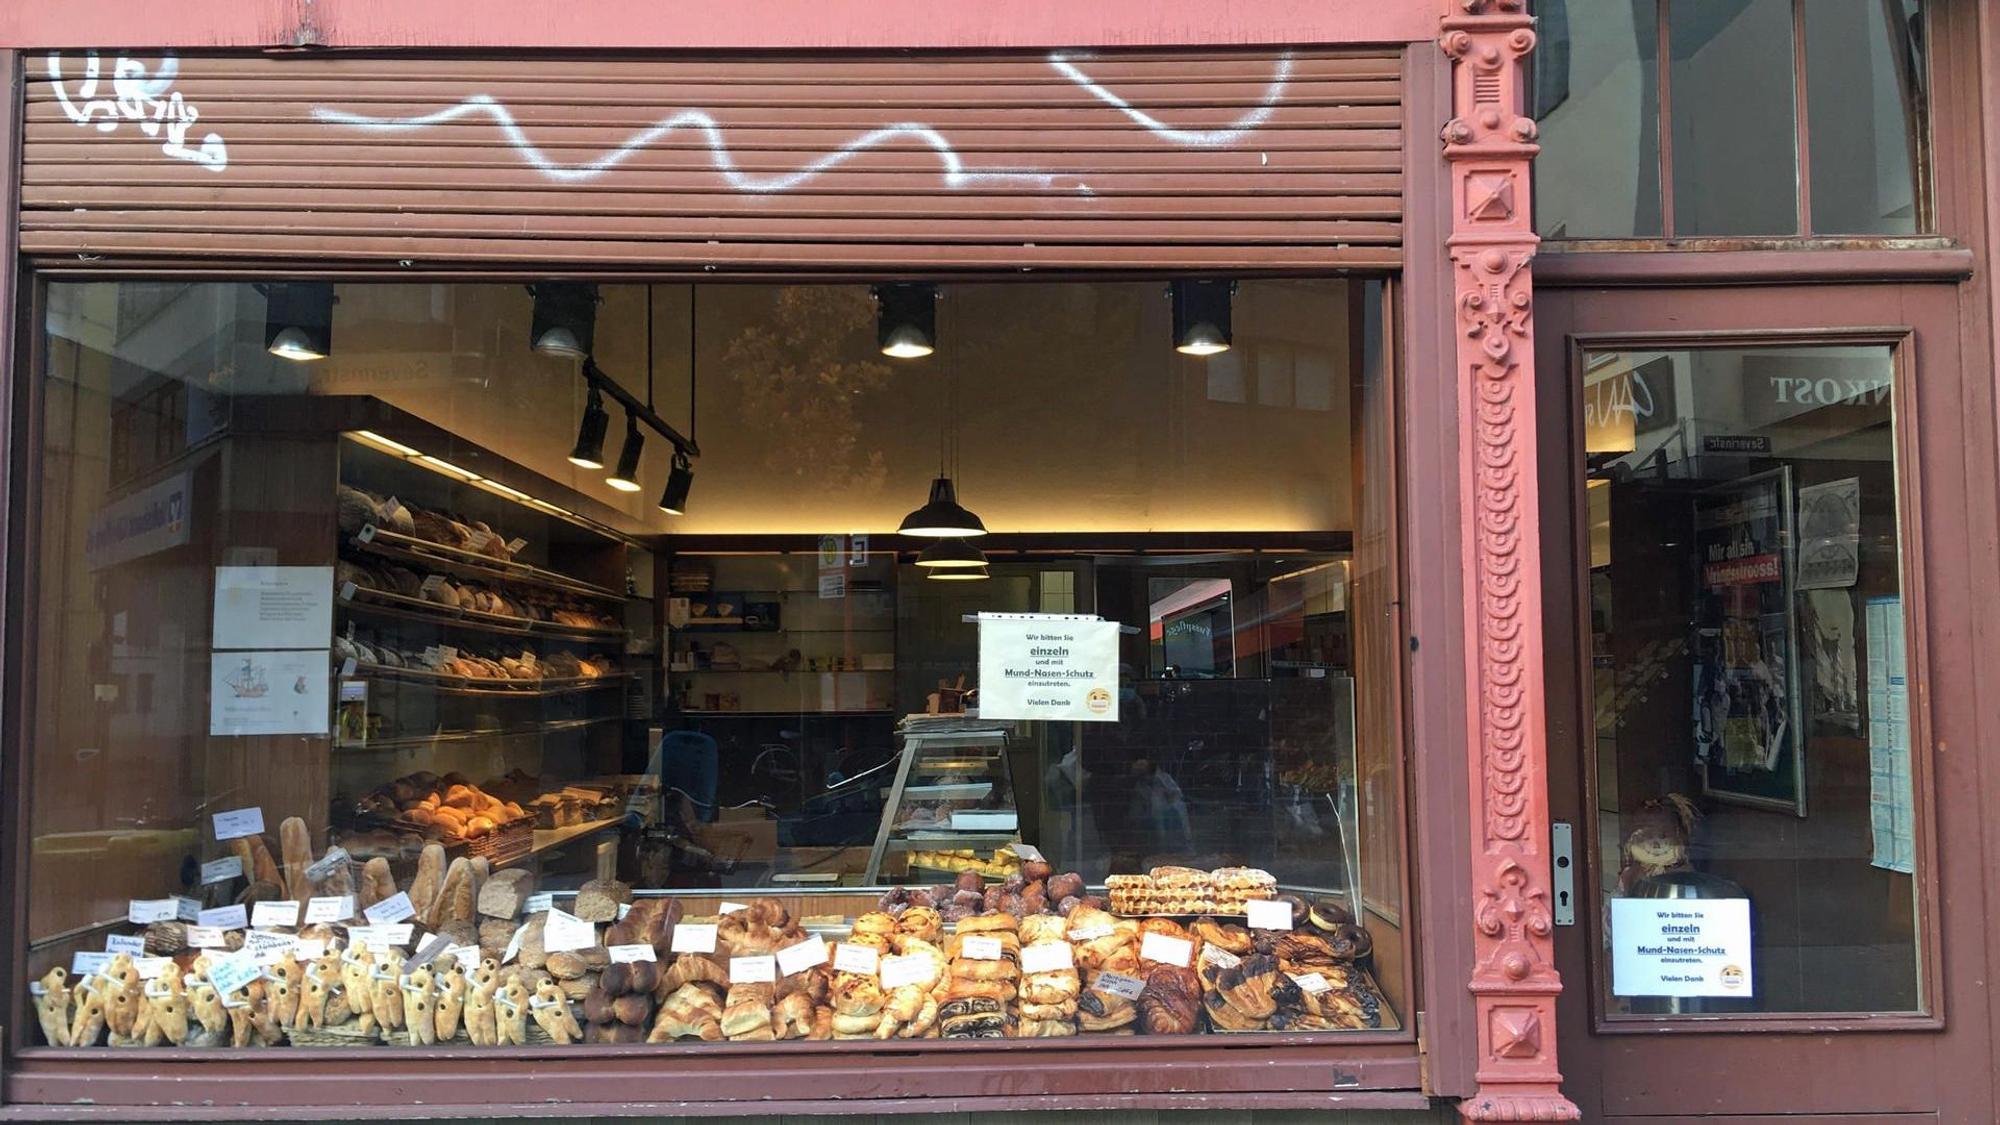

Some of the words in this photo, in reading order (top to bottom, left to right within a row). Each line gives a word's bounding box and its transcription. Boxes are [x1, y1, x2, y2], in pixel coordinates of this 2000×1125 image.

[1030, 646, 1069, 656] einzeln
[1005, 669, 1094, 678] Mund-Nasen-Schutz
[1661, 924, 1700, 933] einzeln
[1637, 946, 1726, 955] Mund-Nasen-Schutz
